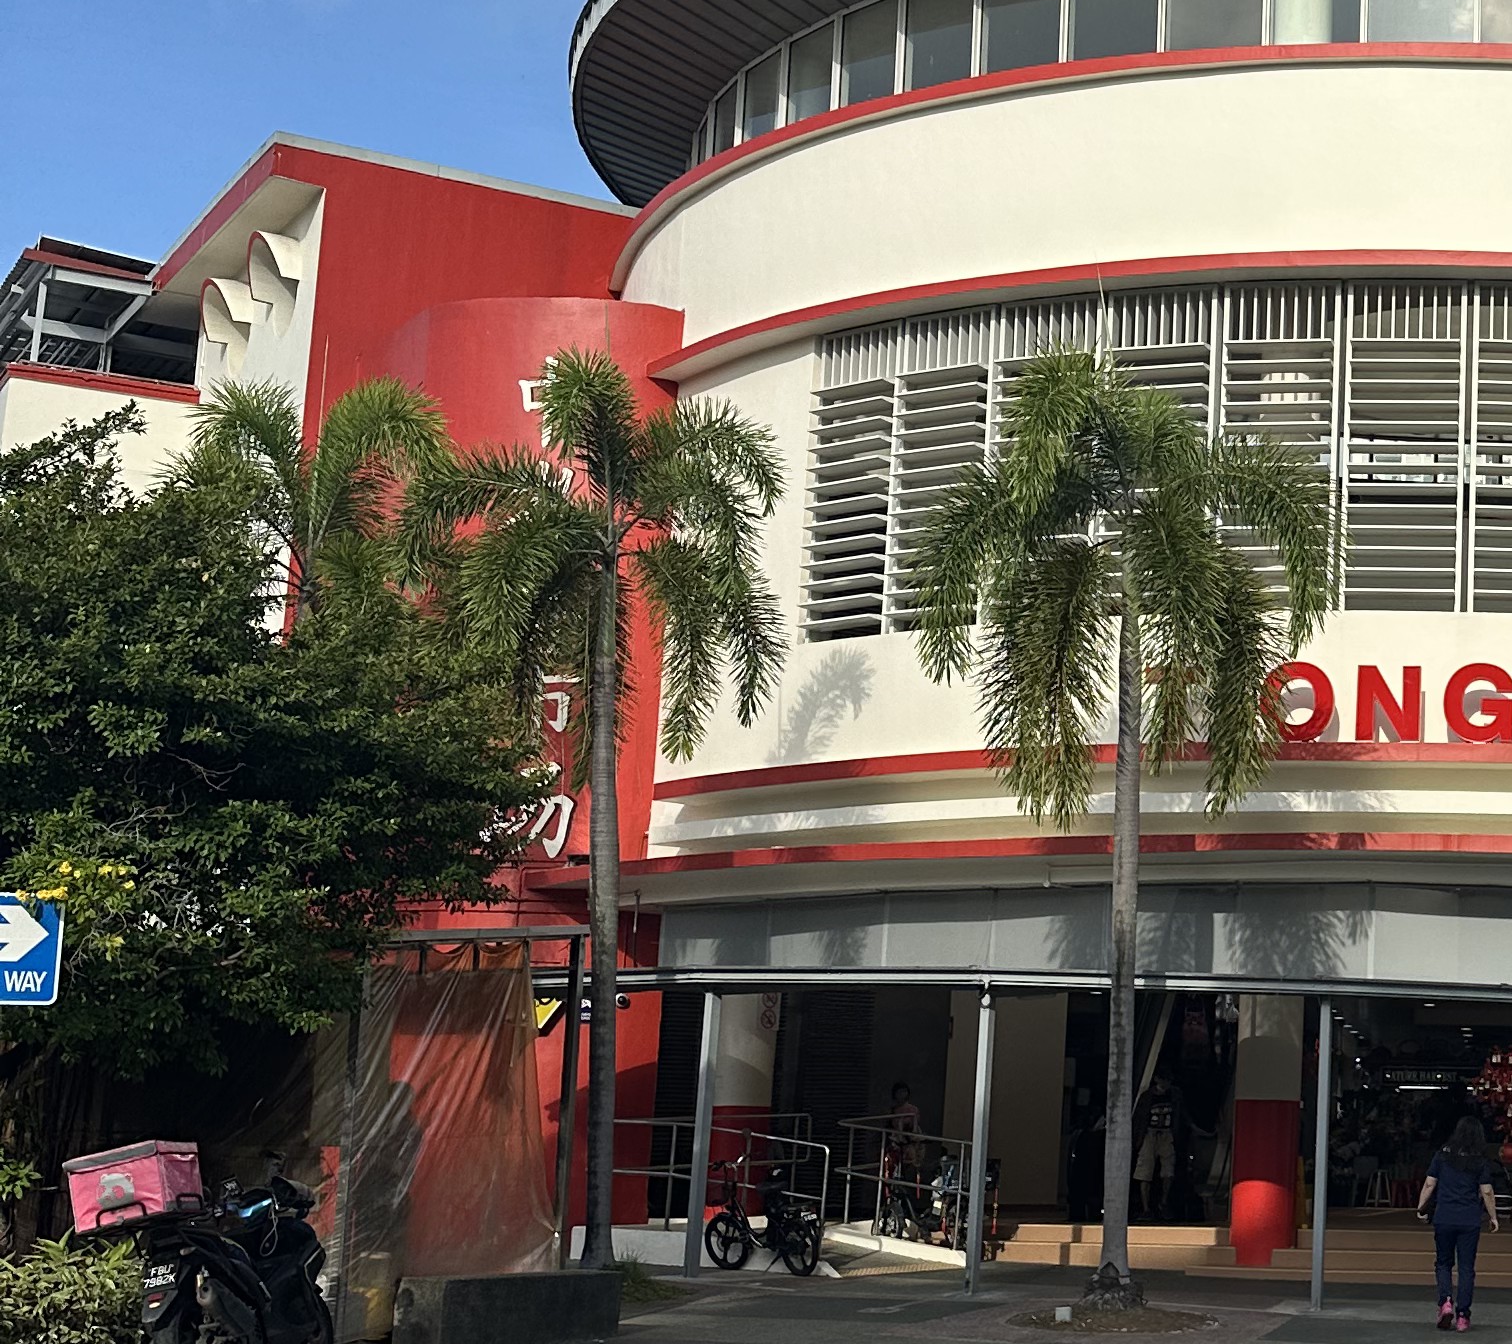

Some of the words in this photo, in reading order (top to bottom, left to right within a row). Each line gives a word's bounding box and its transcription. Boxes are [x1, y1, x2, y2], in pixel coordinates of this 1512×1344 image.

[4, 970, 48, 993] WAY
[1384, 1070, 1417, 1083] ATURE
[1419, 1070, 1457, 1083] HAREST
